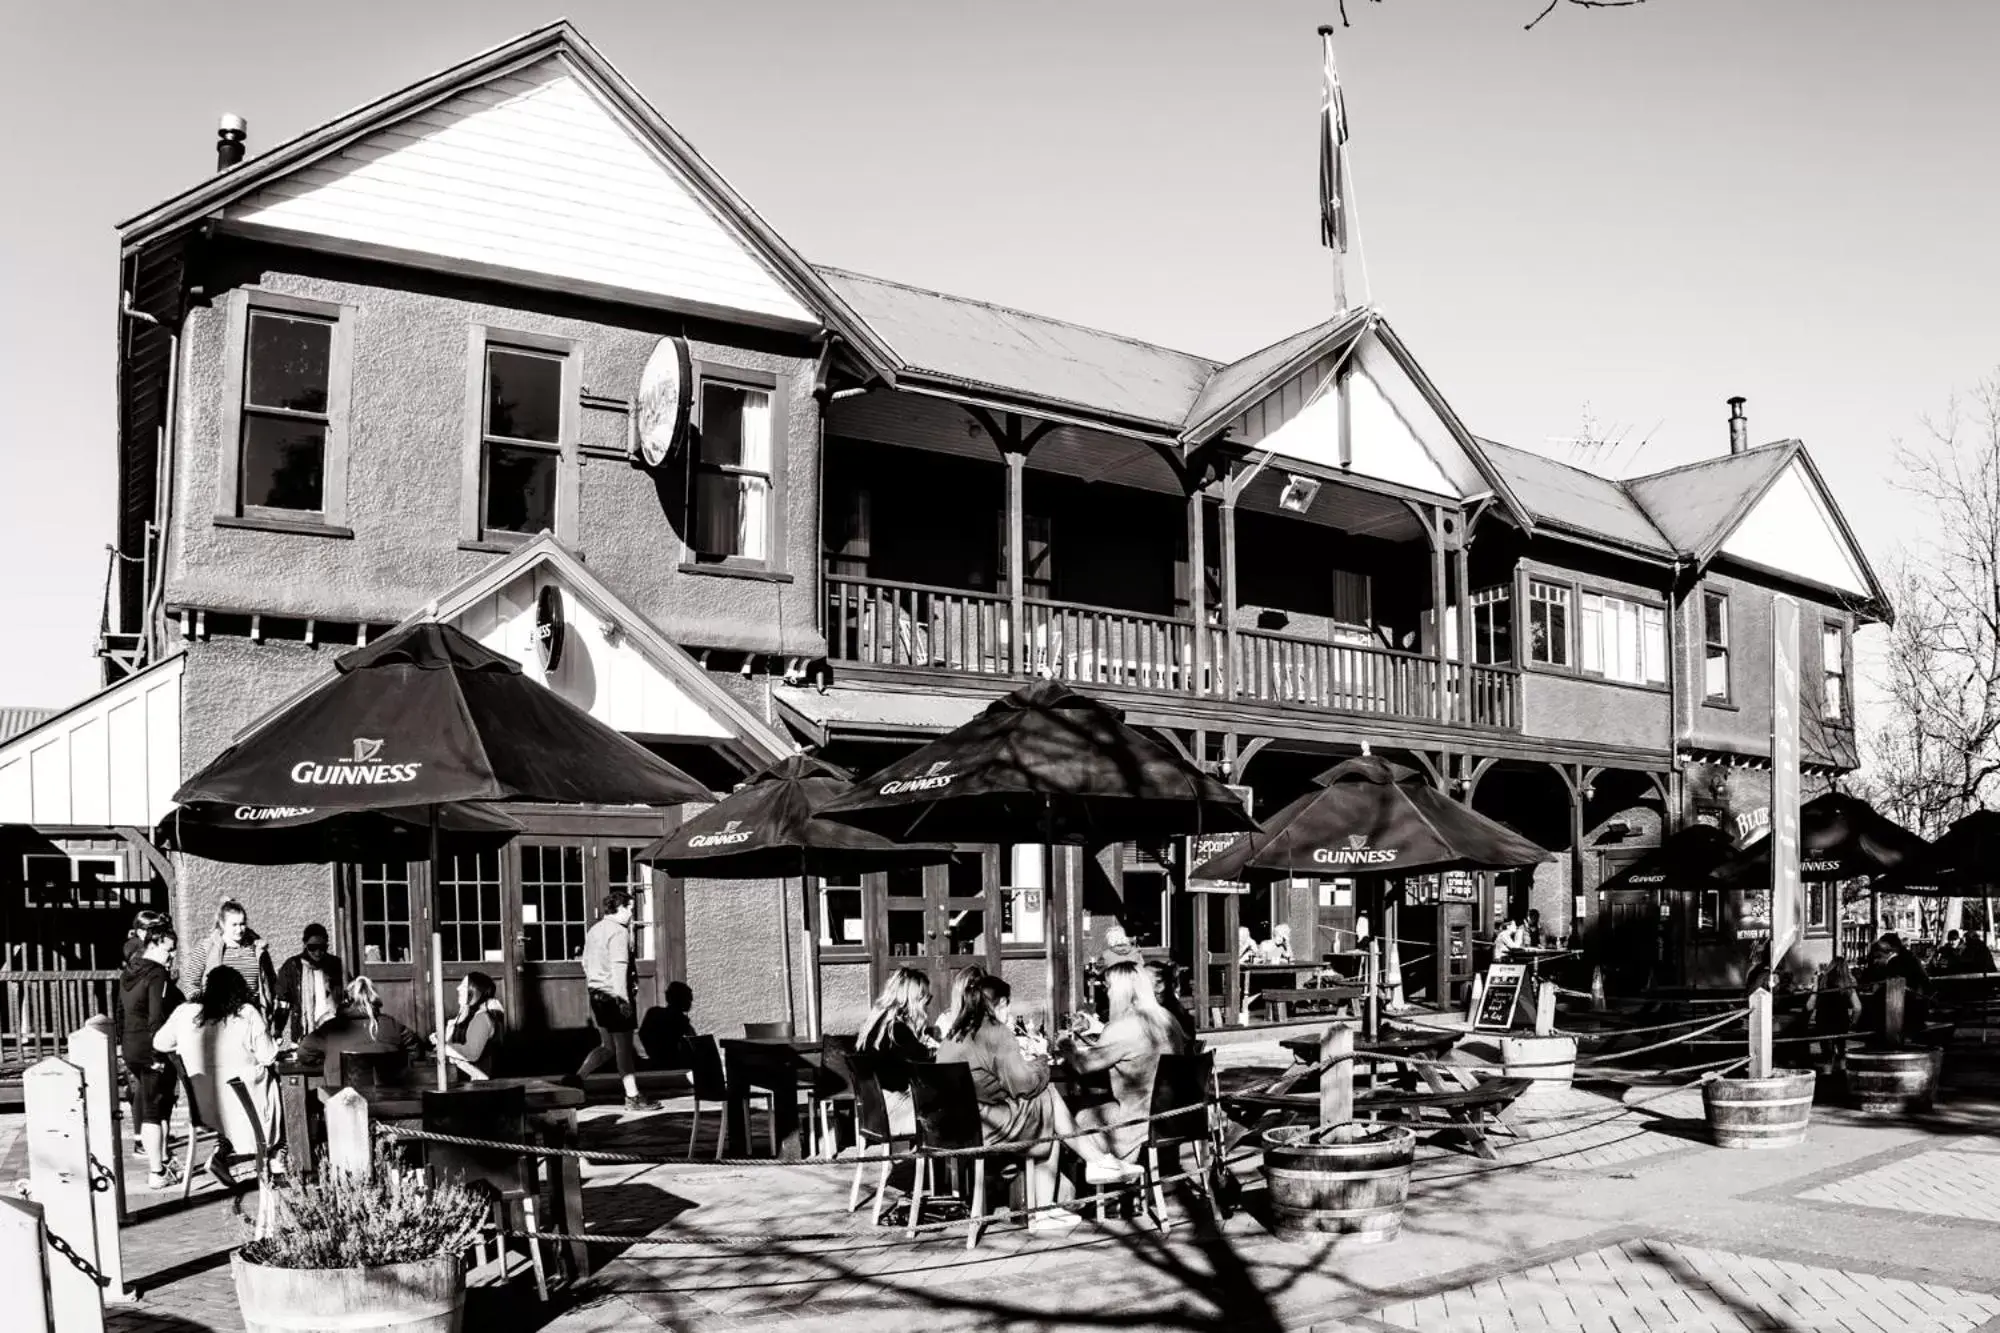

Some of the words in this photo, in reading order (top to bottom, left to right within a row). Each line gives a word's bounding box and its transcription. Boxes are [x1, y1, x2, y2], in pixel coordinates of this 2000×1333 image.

[291, 761, 420, 784] GUINNESS
[880, 775, 955, 794] GUINNESS
[688, 832, 751, 847] GUINNESS
[1313, 848, 1397, 864] GUINNESS
[1800, 860, 1841, 872] INNESS
